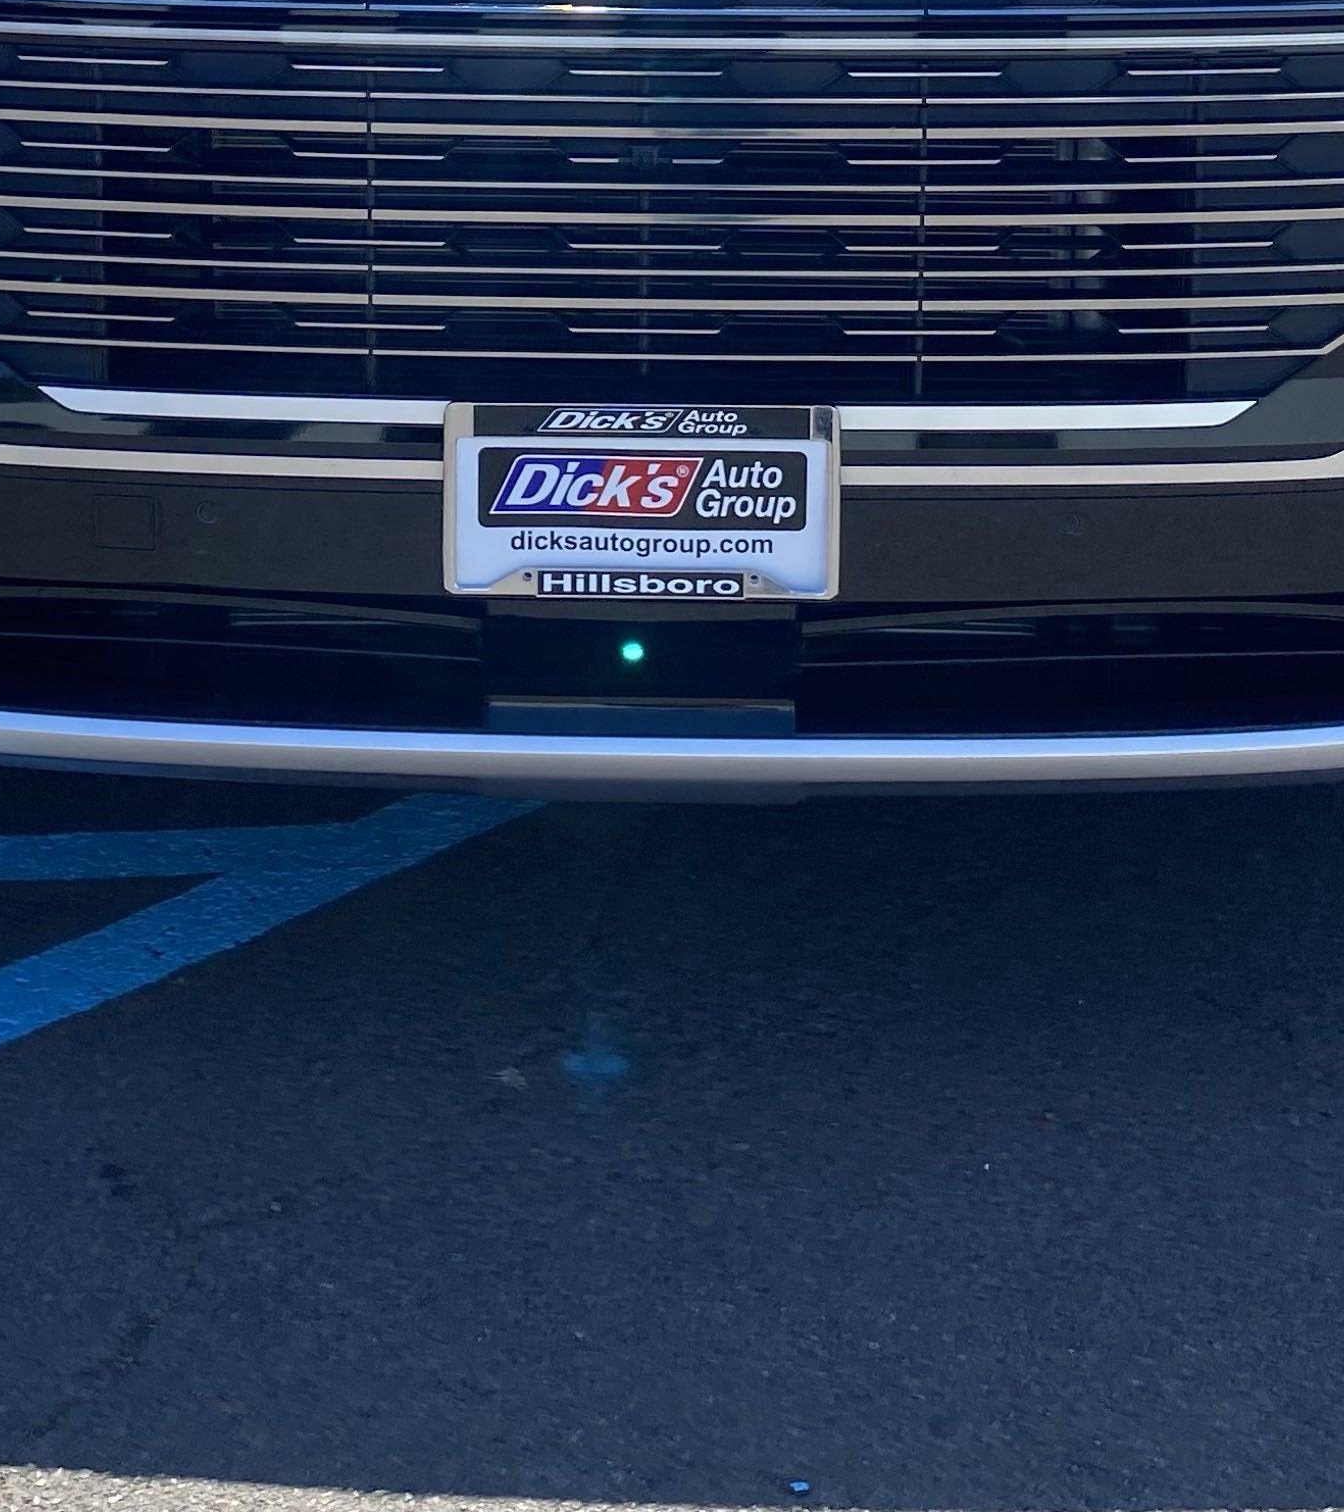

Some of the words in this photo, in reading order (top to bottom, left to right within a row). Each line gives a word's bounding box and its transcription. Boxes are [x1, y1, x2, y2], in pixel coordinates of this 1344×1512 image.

[548, 411, 667, 430] Dick's
[683, 409, 738, 423] Auto
[678, 422, 747, 436] Group
[504, 461, 679, 508] Dick's
[701, 459, 783, 488] Auto
[696, 488, 796, 524] Group
[510, 530, 774, 558] dicksautogroup.com
[543, 573, 740, 596] Hillsboro
